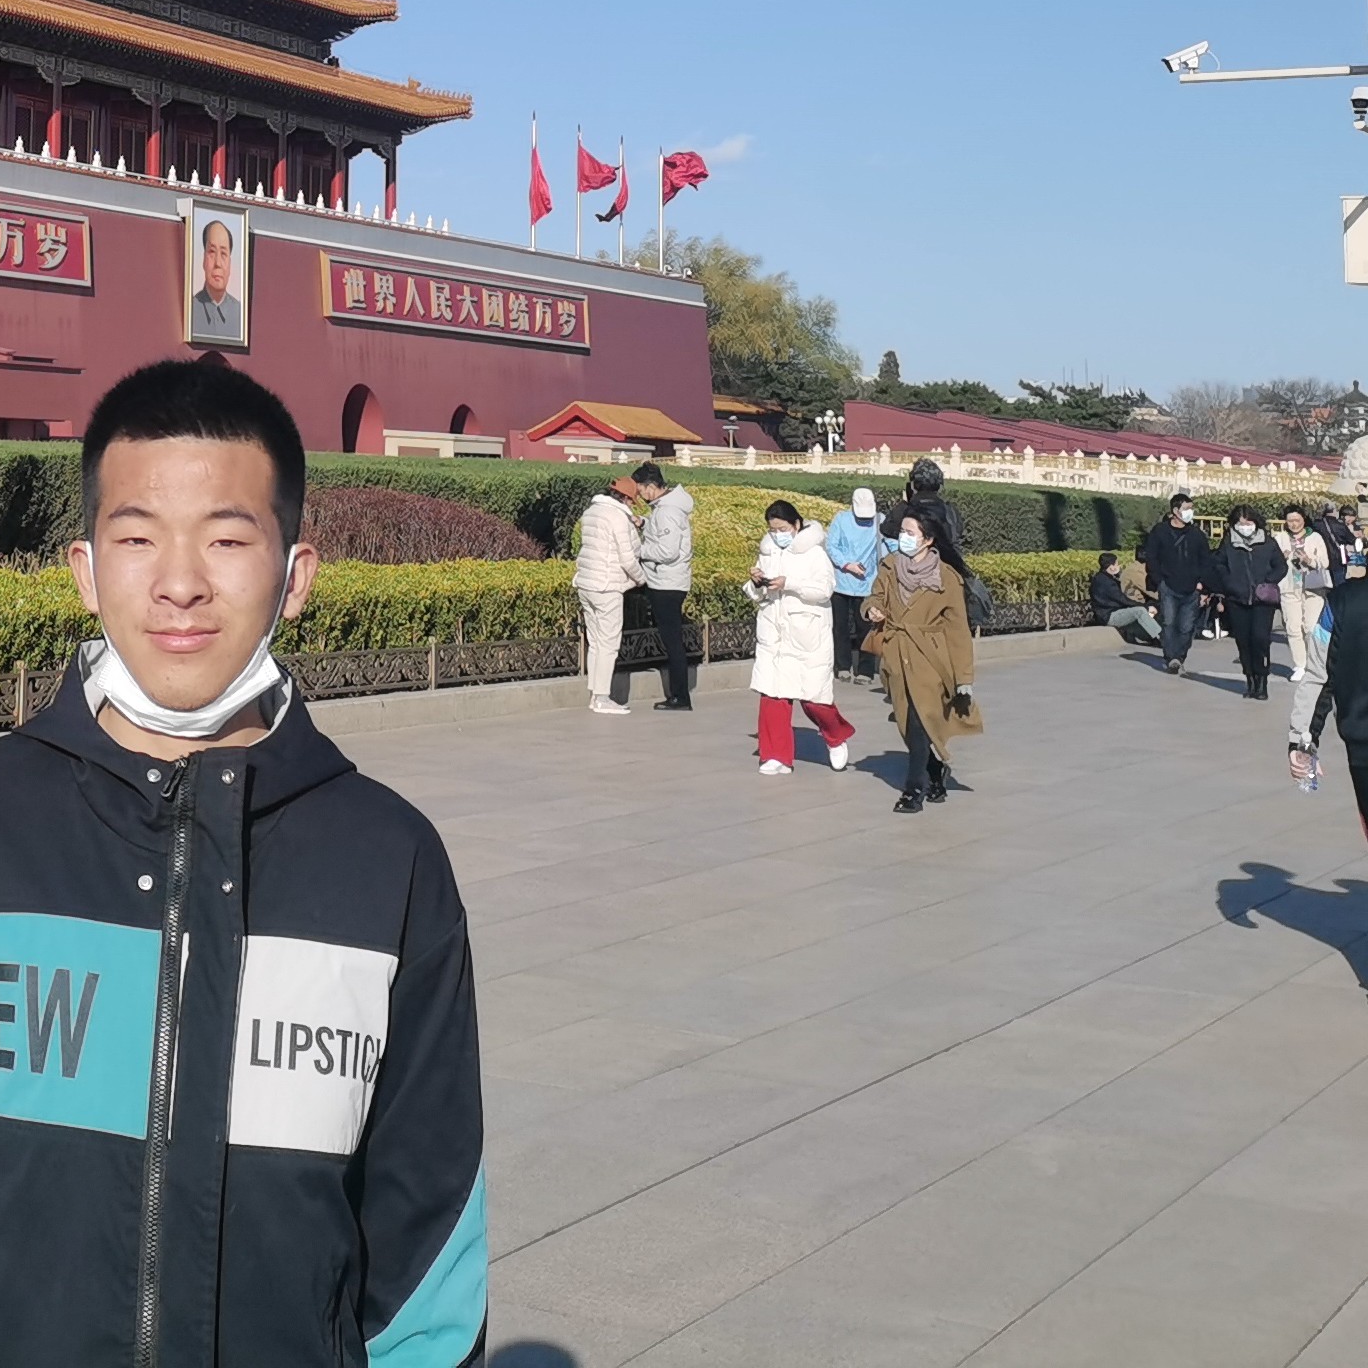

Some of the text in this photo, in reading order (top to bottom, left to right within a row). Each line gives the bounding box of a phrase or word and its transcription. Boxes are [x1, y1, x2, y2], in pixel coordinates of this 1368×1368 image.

[342, 268, 576, 337] 世界人民大团结万岁
